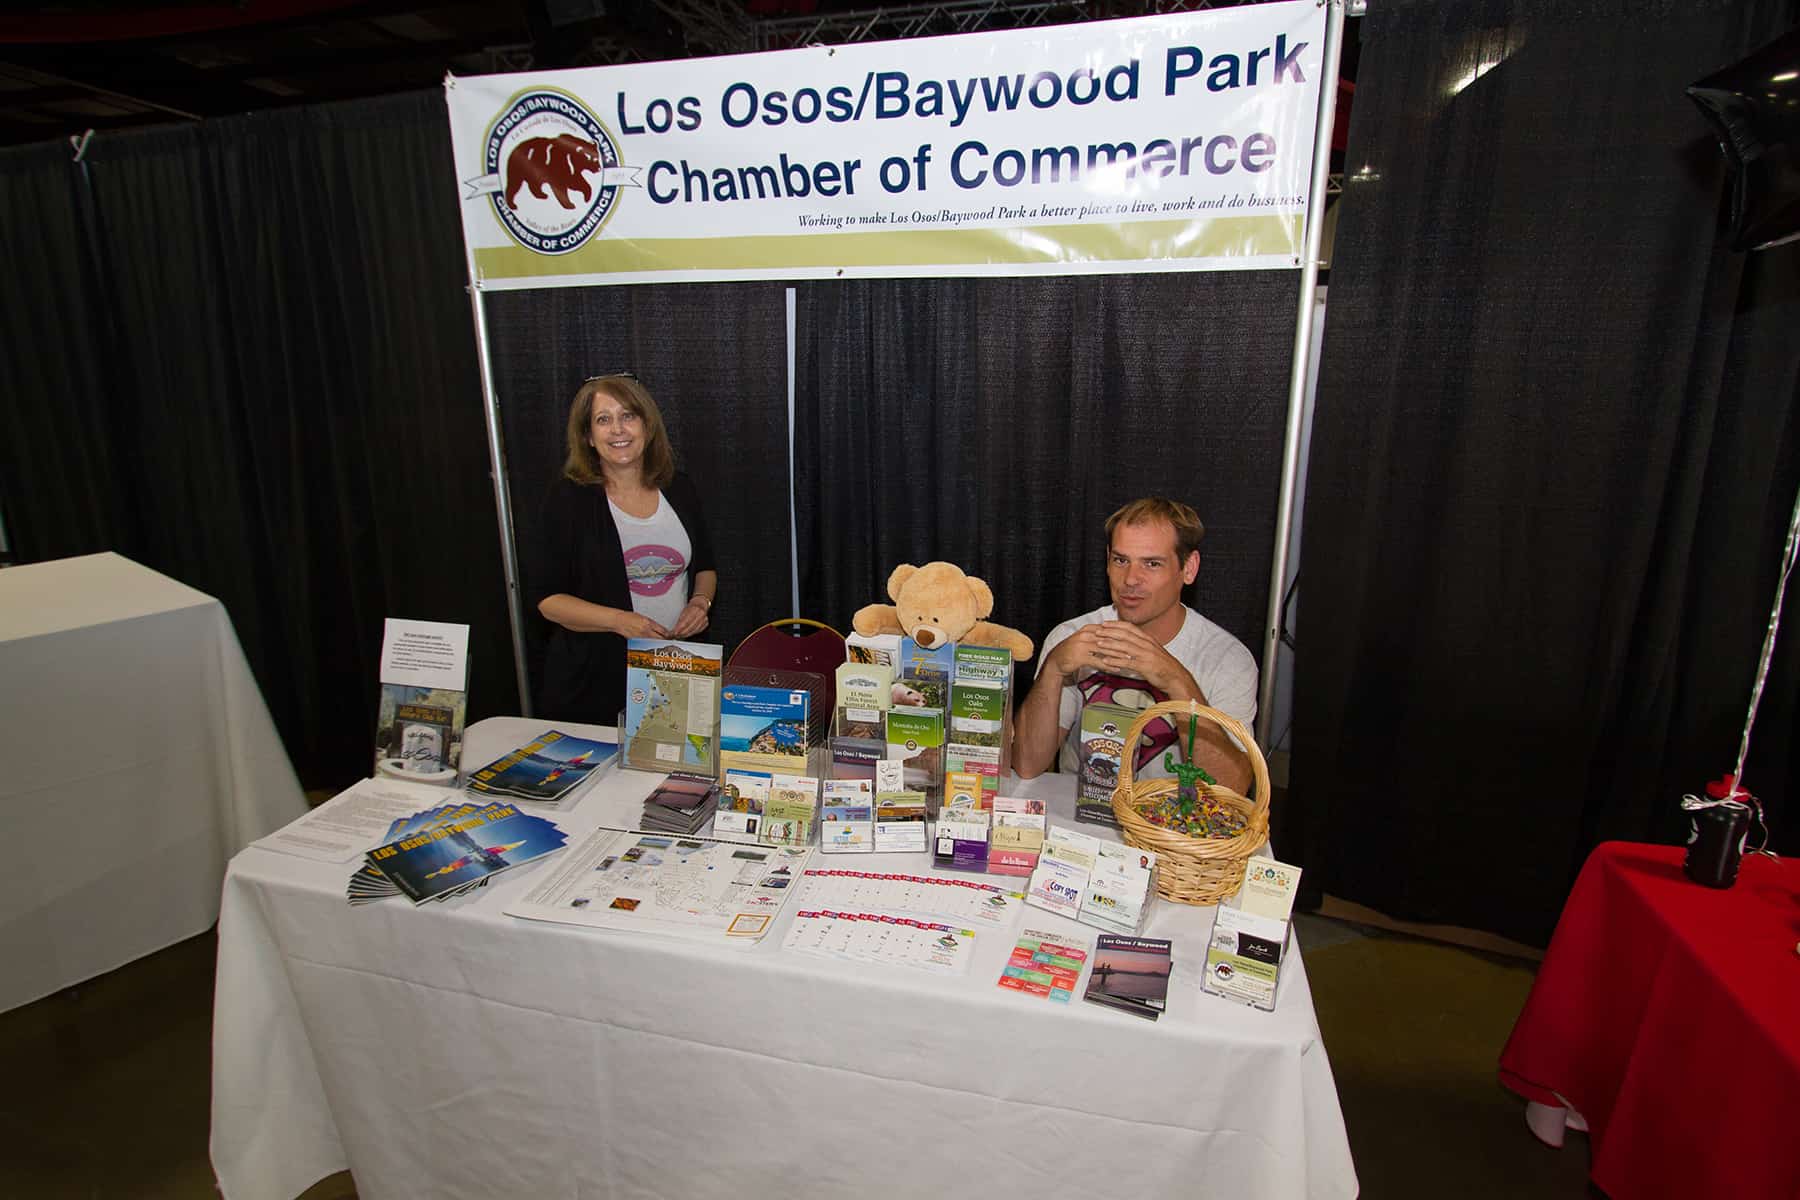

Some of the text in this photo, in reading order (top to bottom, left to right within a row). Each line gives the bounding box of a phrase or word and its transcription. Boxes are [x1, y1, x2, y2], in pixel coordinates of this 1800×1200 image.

[617, 33, 1309, 135] Los Osos/Baywood Park
[488, 137, 500, 167] LOS
[588, 123, 615, 164] PARK
[647, 131, 1276, 204] Chamber of Commerce
[496, 188, 614, 250] CHAMBER OF COMMERCE
[798, 213, 843, 229] Working
[845, 215, 856, 225] to
[859, 211, 887, 224] make
[890, 210, 909, 224] Los
[911, 206, 995, 226] Osos/Baywood
[998, 204, 1027, 219] Park
[1029, 207, 1037, 218] a
[1041, 203, 1077, 217] better
[1079, 201, 1112, 219] place
[1116, 202, 1128, 213] to
[1131, 199, 1158, 213] live,
[1162, 196, 1196, 211] work
[1198, 194, 1225, 210] and
[1228, 193, 1245, 208] do
[653, 657, 693, 672] Baywood
[654, 648, 693, 661] Los Osos
[962, 692, 973, 700] Los
[1115, 938, 1132, 946] Osos
[1137, 941, 1169, 949] Baywood
